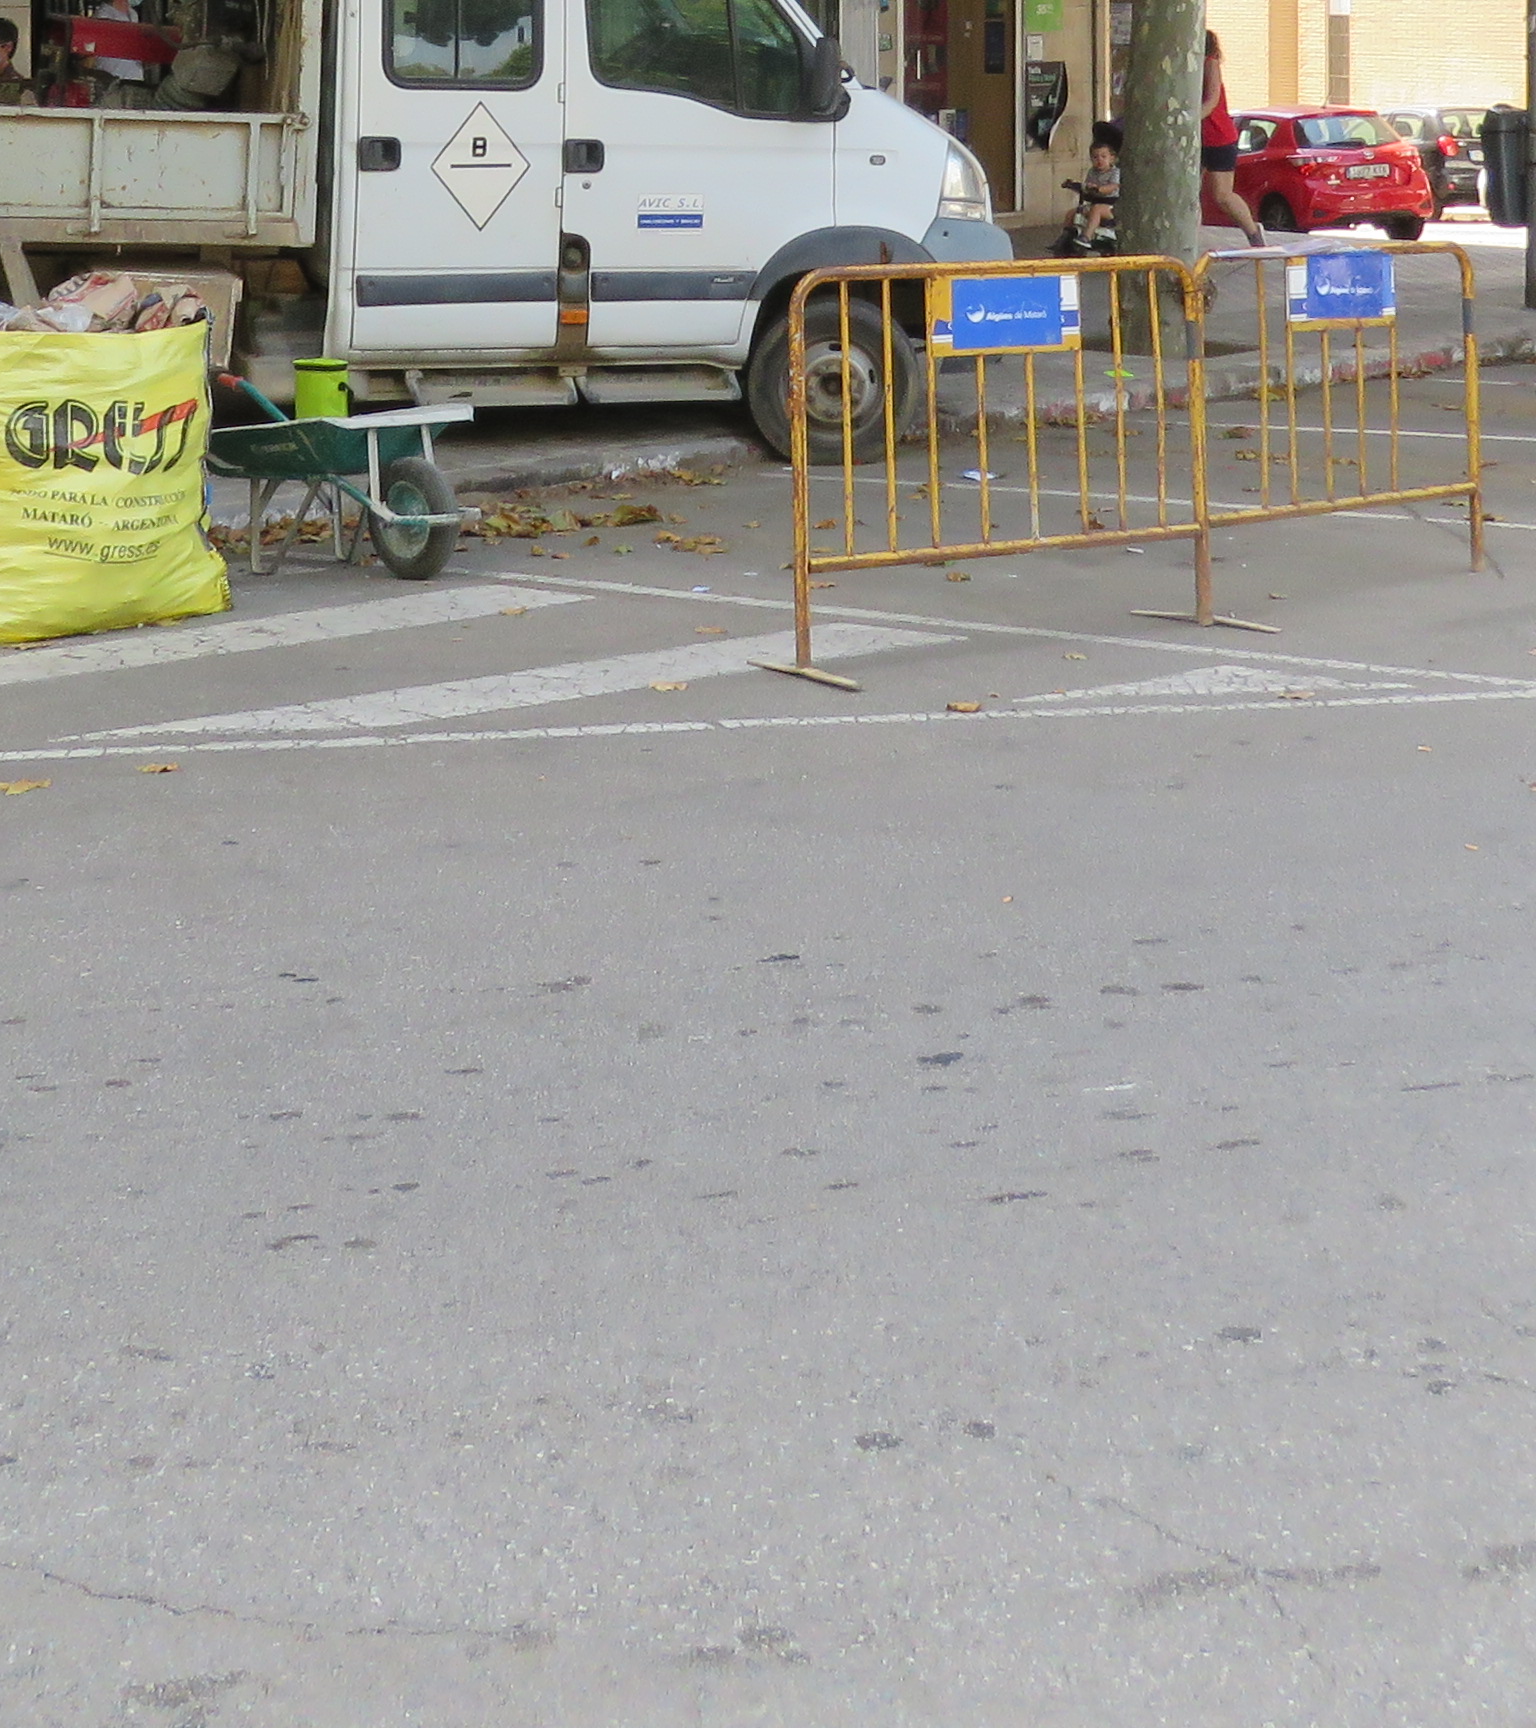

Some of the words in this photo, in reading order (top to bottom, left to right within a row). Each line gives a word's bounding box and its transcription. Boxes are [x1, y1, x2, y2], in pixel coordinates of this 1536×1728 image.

[472, 137, 487, 157] B
[638, 198, 672, 208] AVIC
[22, 506, 93, 529] MATARÓ
